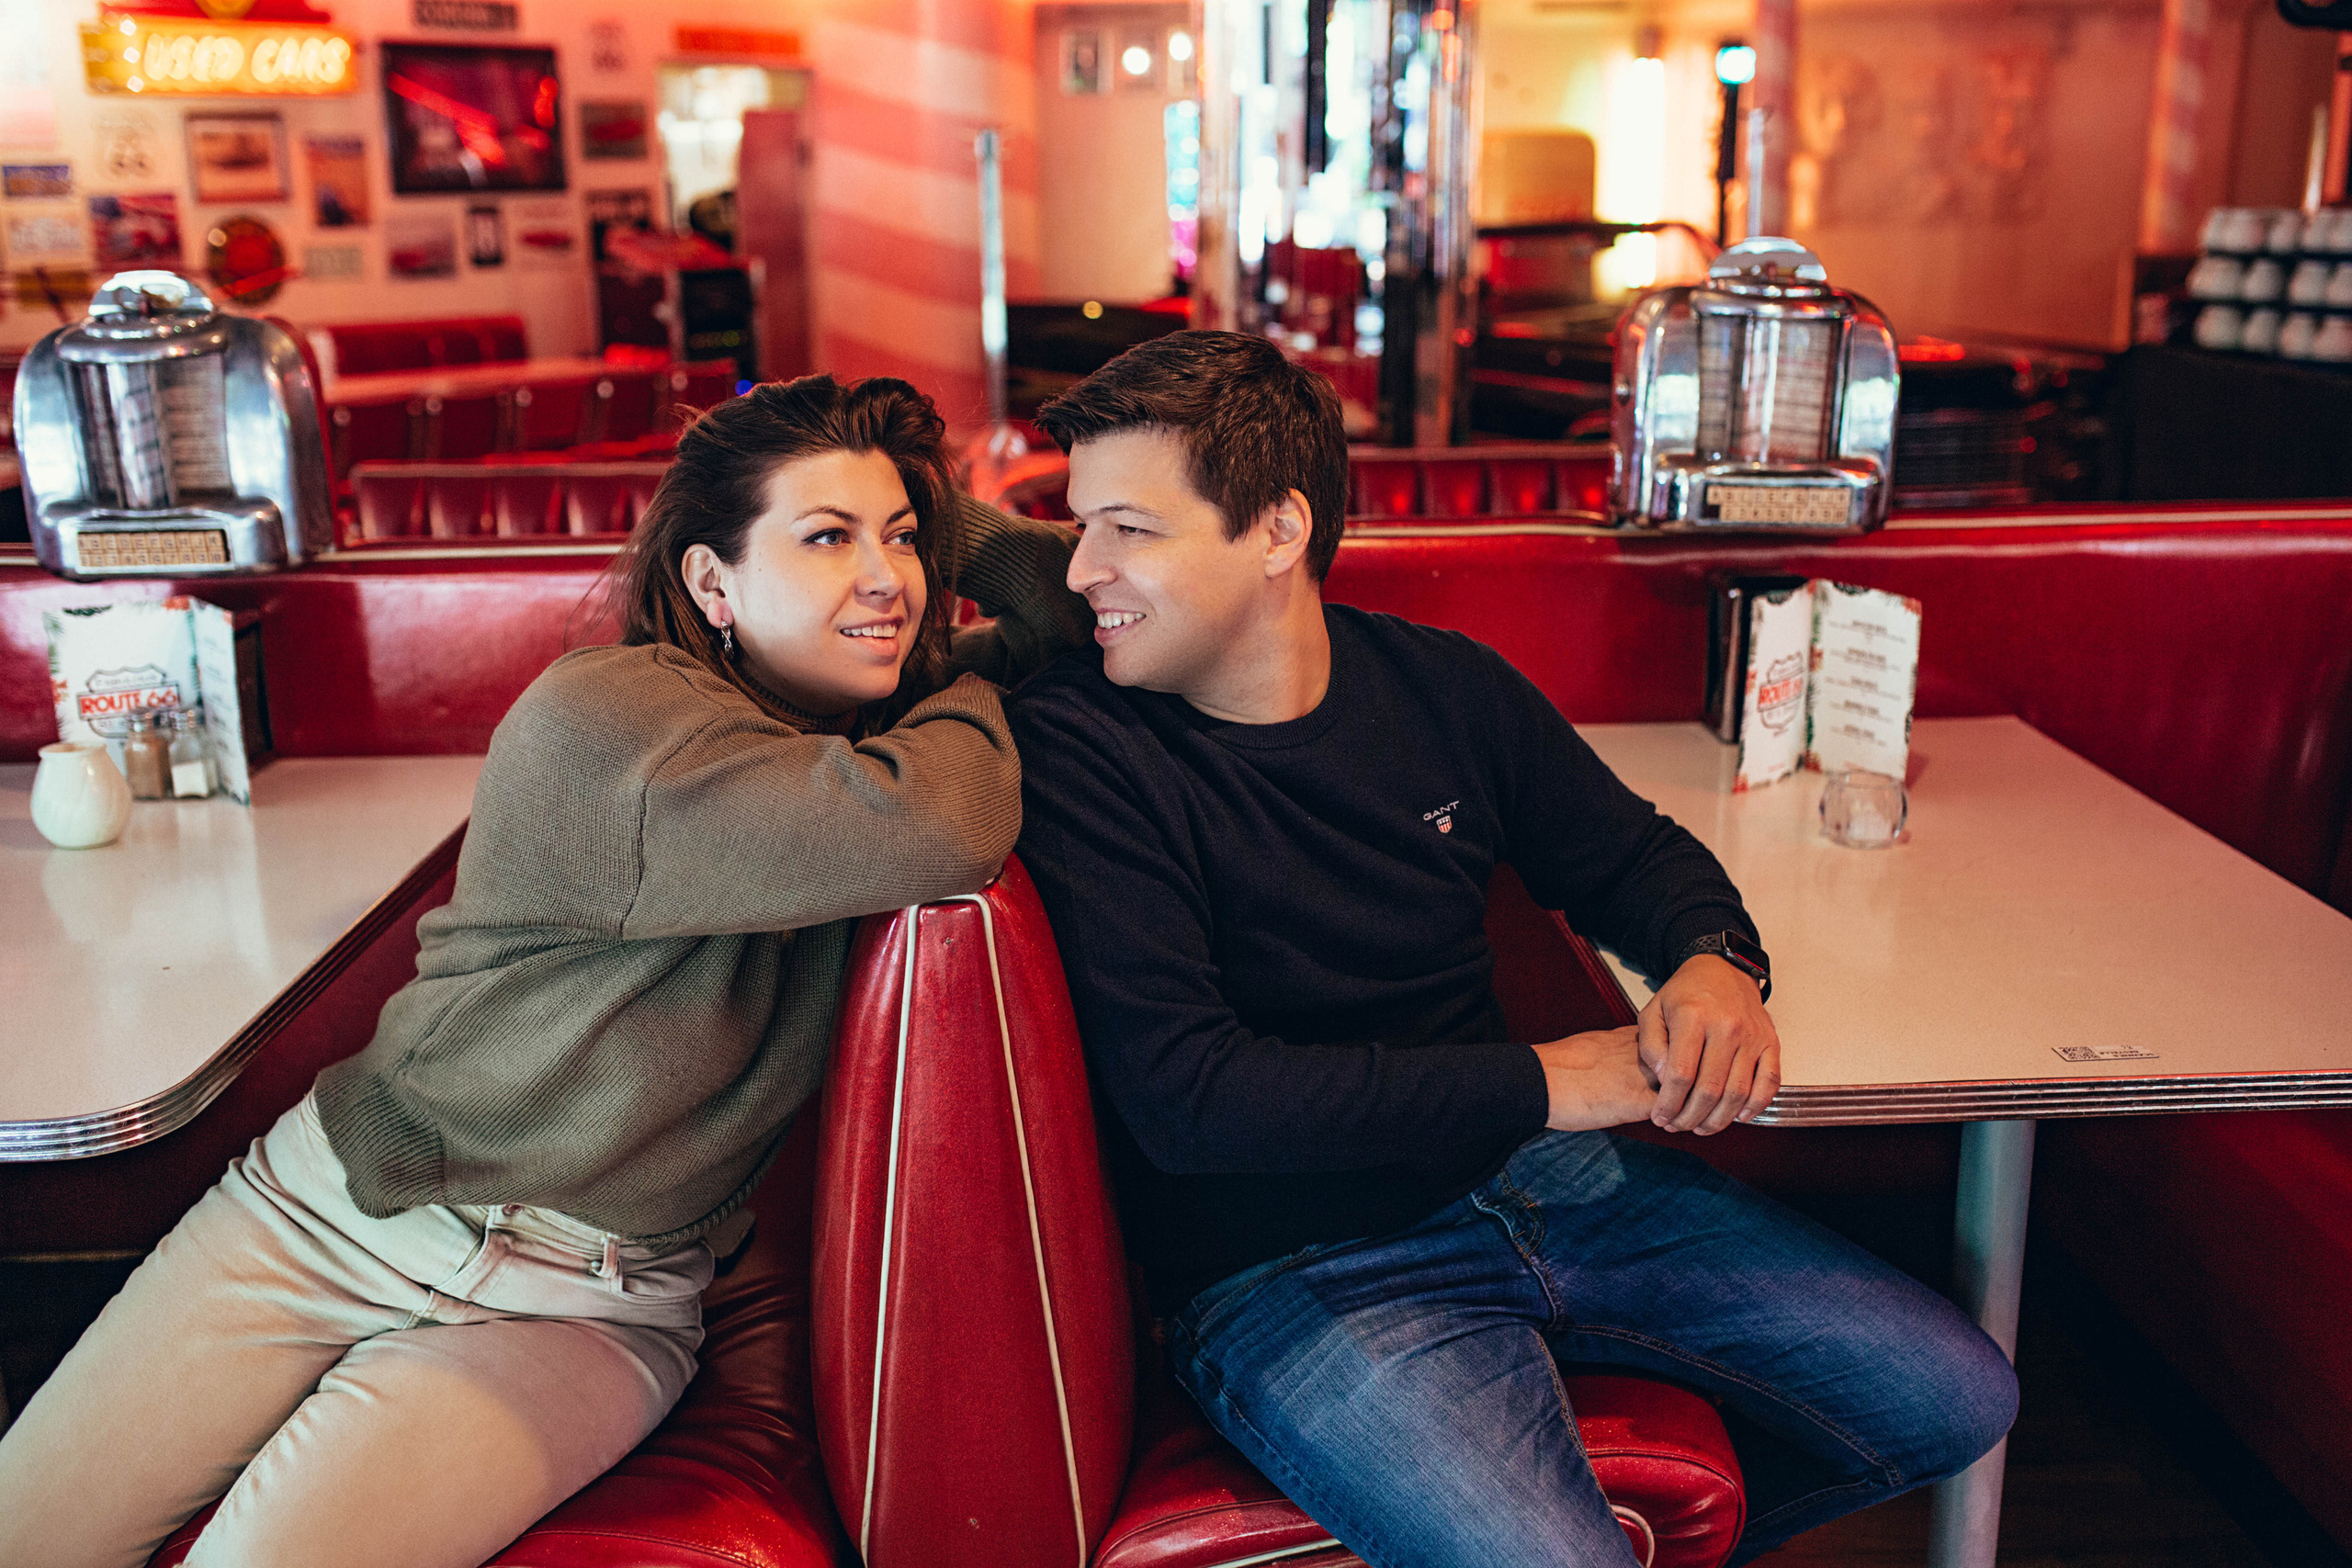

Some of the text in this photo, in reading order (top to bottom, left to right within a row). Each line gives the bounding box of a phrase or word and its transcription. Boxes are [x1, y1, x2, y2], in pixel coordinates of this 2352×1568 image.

[143, 33, 351, 84] USED CARS
[80, 688, 177, 715] ROUTE 66
[1423, 800, 1460, 821] GANT
